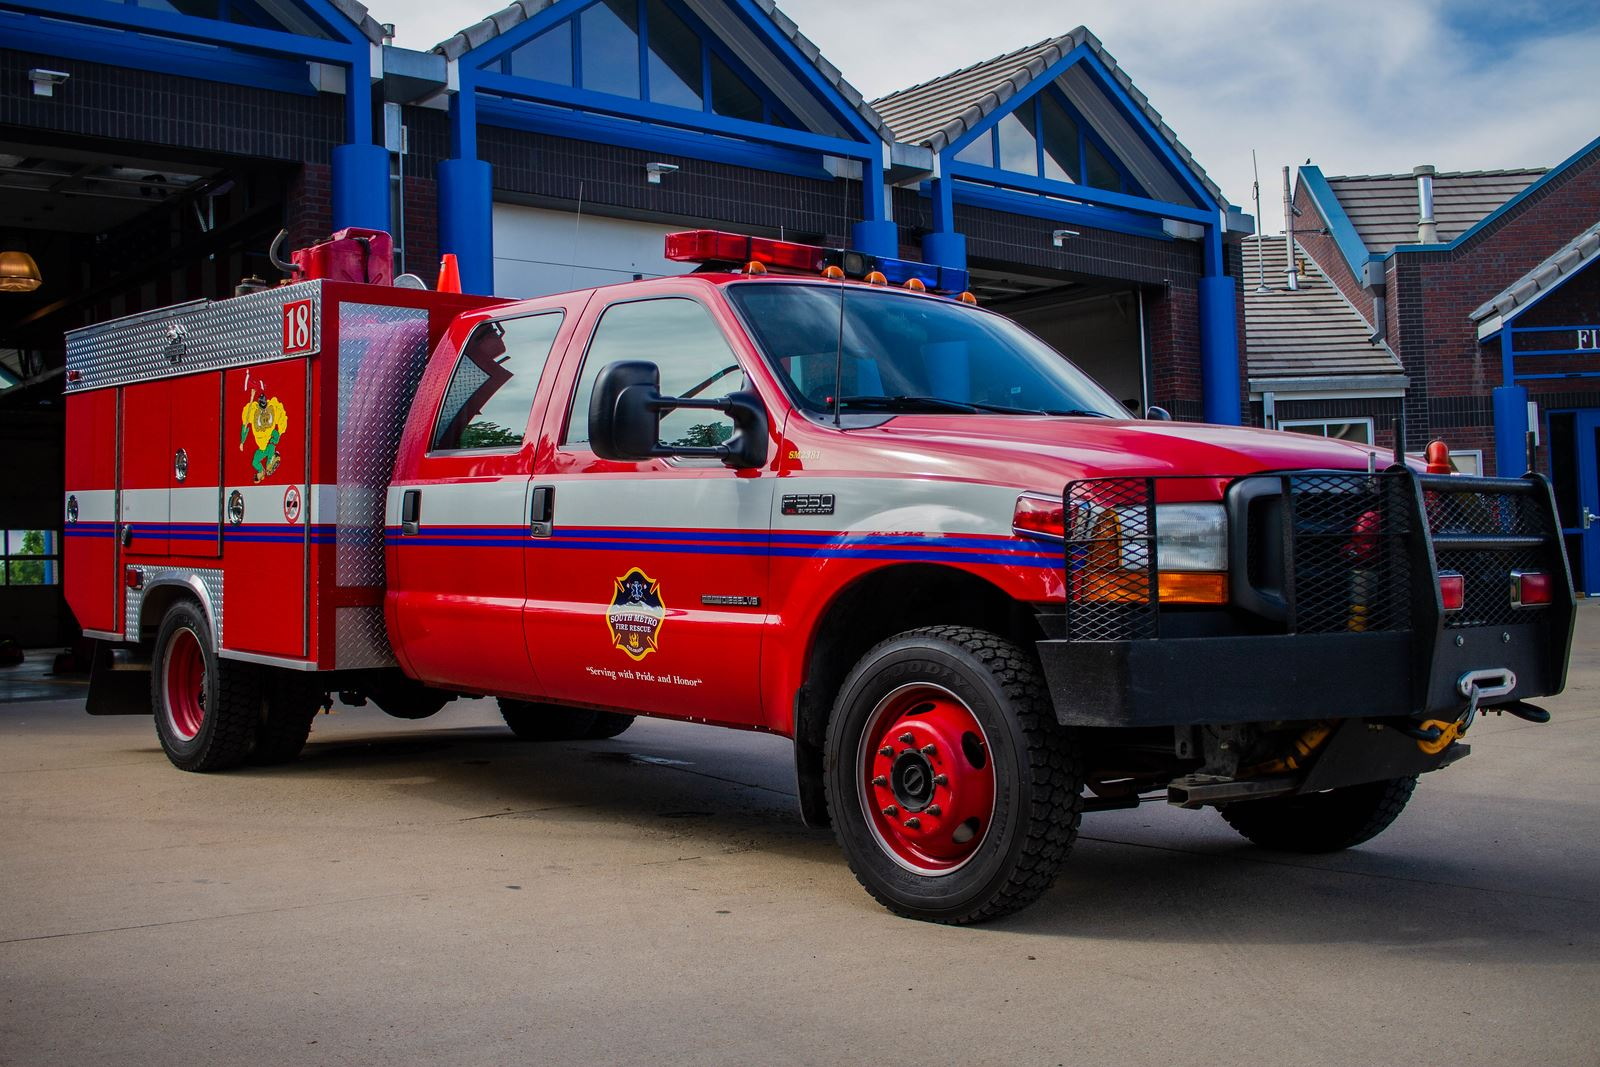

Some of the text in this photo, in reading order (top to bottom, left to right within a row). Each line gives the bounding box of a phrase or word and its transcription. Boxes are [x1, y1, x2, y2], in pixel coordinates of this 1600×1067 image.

[286, 304, 308, 349] 18
[1575, 329, 1600, 350] FI
[610, 614, 658, 627] SOUTH METRO
[615, 623, 652, 633] FIRE RESCUE
[618, 670, 634, 680] with
[636, 671, 655, 682] Pride
[657, 675, 672, 684] and
